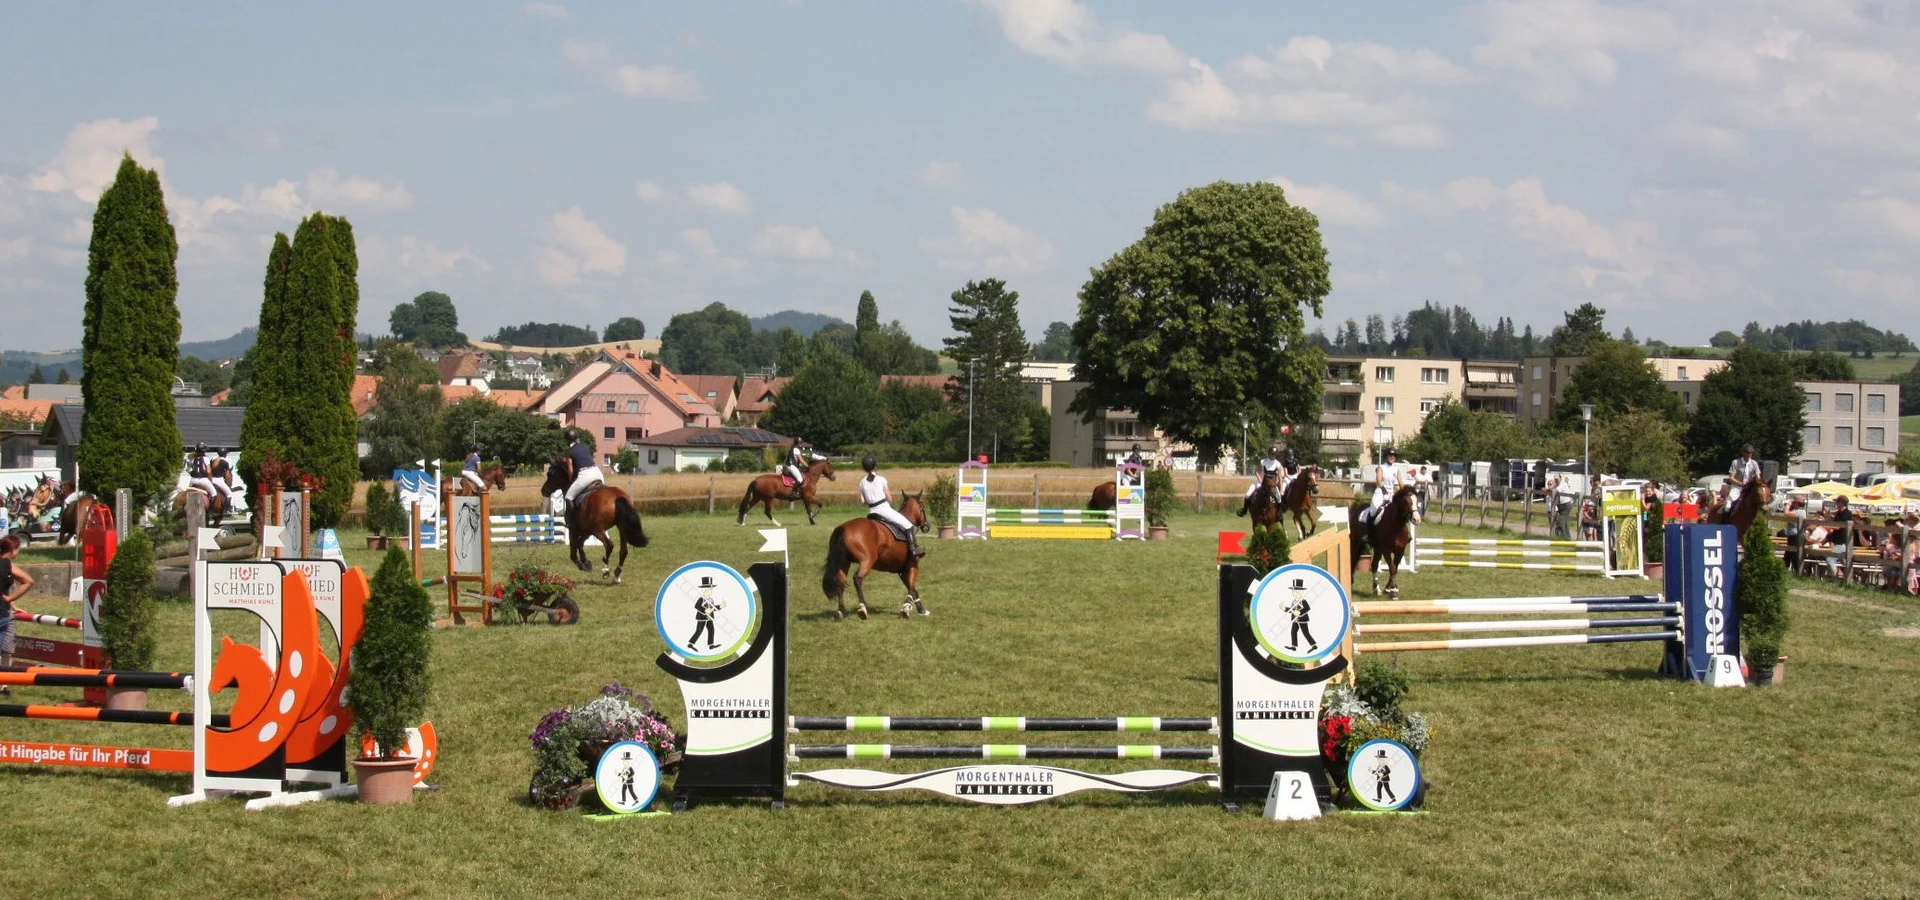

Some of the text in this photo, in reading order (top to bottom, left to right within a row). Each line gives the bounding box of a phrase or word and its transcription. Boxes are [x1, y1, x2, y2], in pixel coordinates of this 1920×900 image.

[74, 582, 78, 591] 7
[213, 582, 275, 596] SCHMIED
[1704, 530, 1724, 654] ROSSEL
[1723, 660, 1731, 673] 9
[691, 699, 770, 707] MORGENTHALER
[1236, 700, 1314, 708] MORGENTHALER
[691, 710, 770, 718] KAMINFEGER
[1236, 711, 1314, 719] KAMINFEGER
[11, 745, 65, 762] Hingabe
[69, 747, 88, 761] für
[92, 749, 111, 762] Ihr
[115, 750, 150, 764] Pferd
[956, 772, 1053, 782] MORGENTHALER
[956, 785, 1053, 794] KAMINFEGER
[1271, 778, 1278, 798] 2
[1290, 779, 1302, 799] 2
